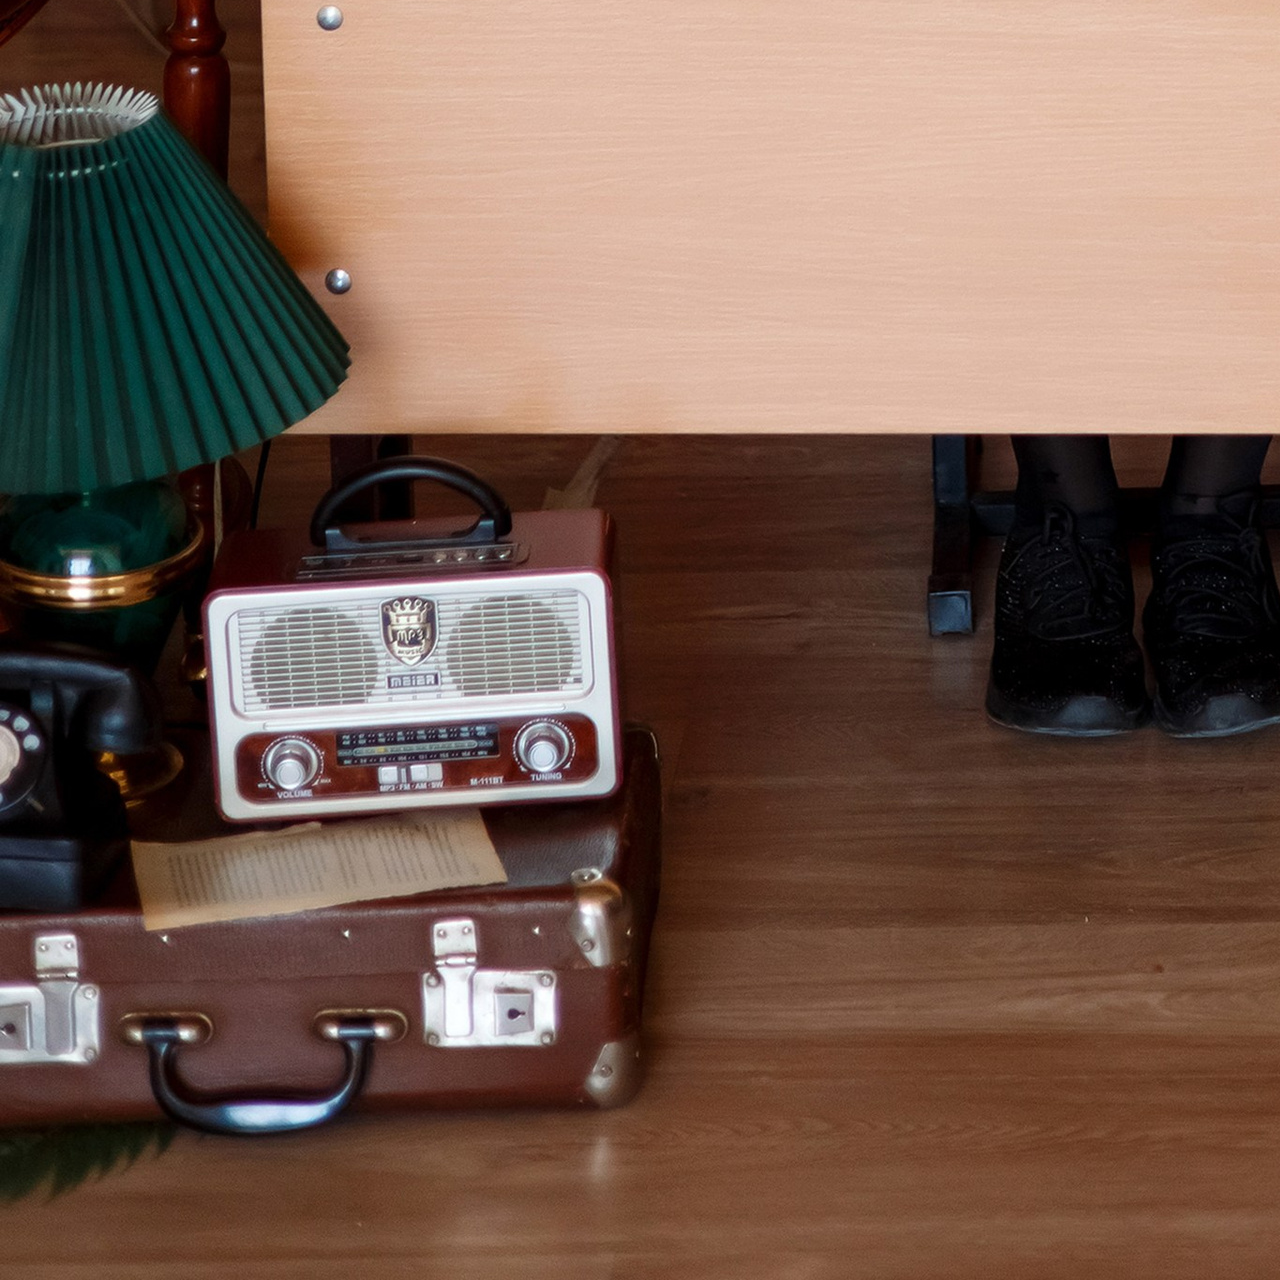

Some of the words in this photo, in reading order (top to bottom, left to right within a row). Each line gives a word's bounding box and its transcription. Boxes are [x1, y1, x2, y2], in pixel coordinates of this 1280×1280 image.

[396, 628, 424, 645] MP3
[390, 674, 435, 688] MEIER
[530, 771, 563, 782] TUNING
[277, 789, 313, 799] VOLUME
